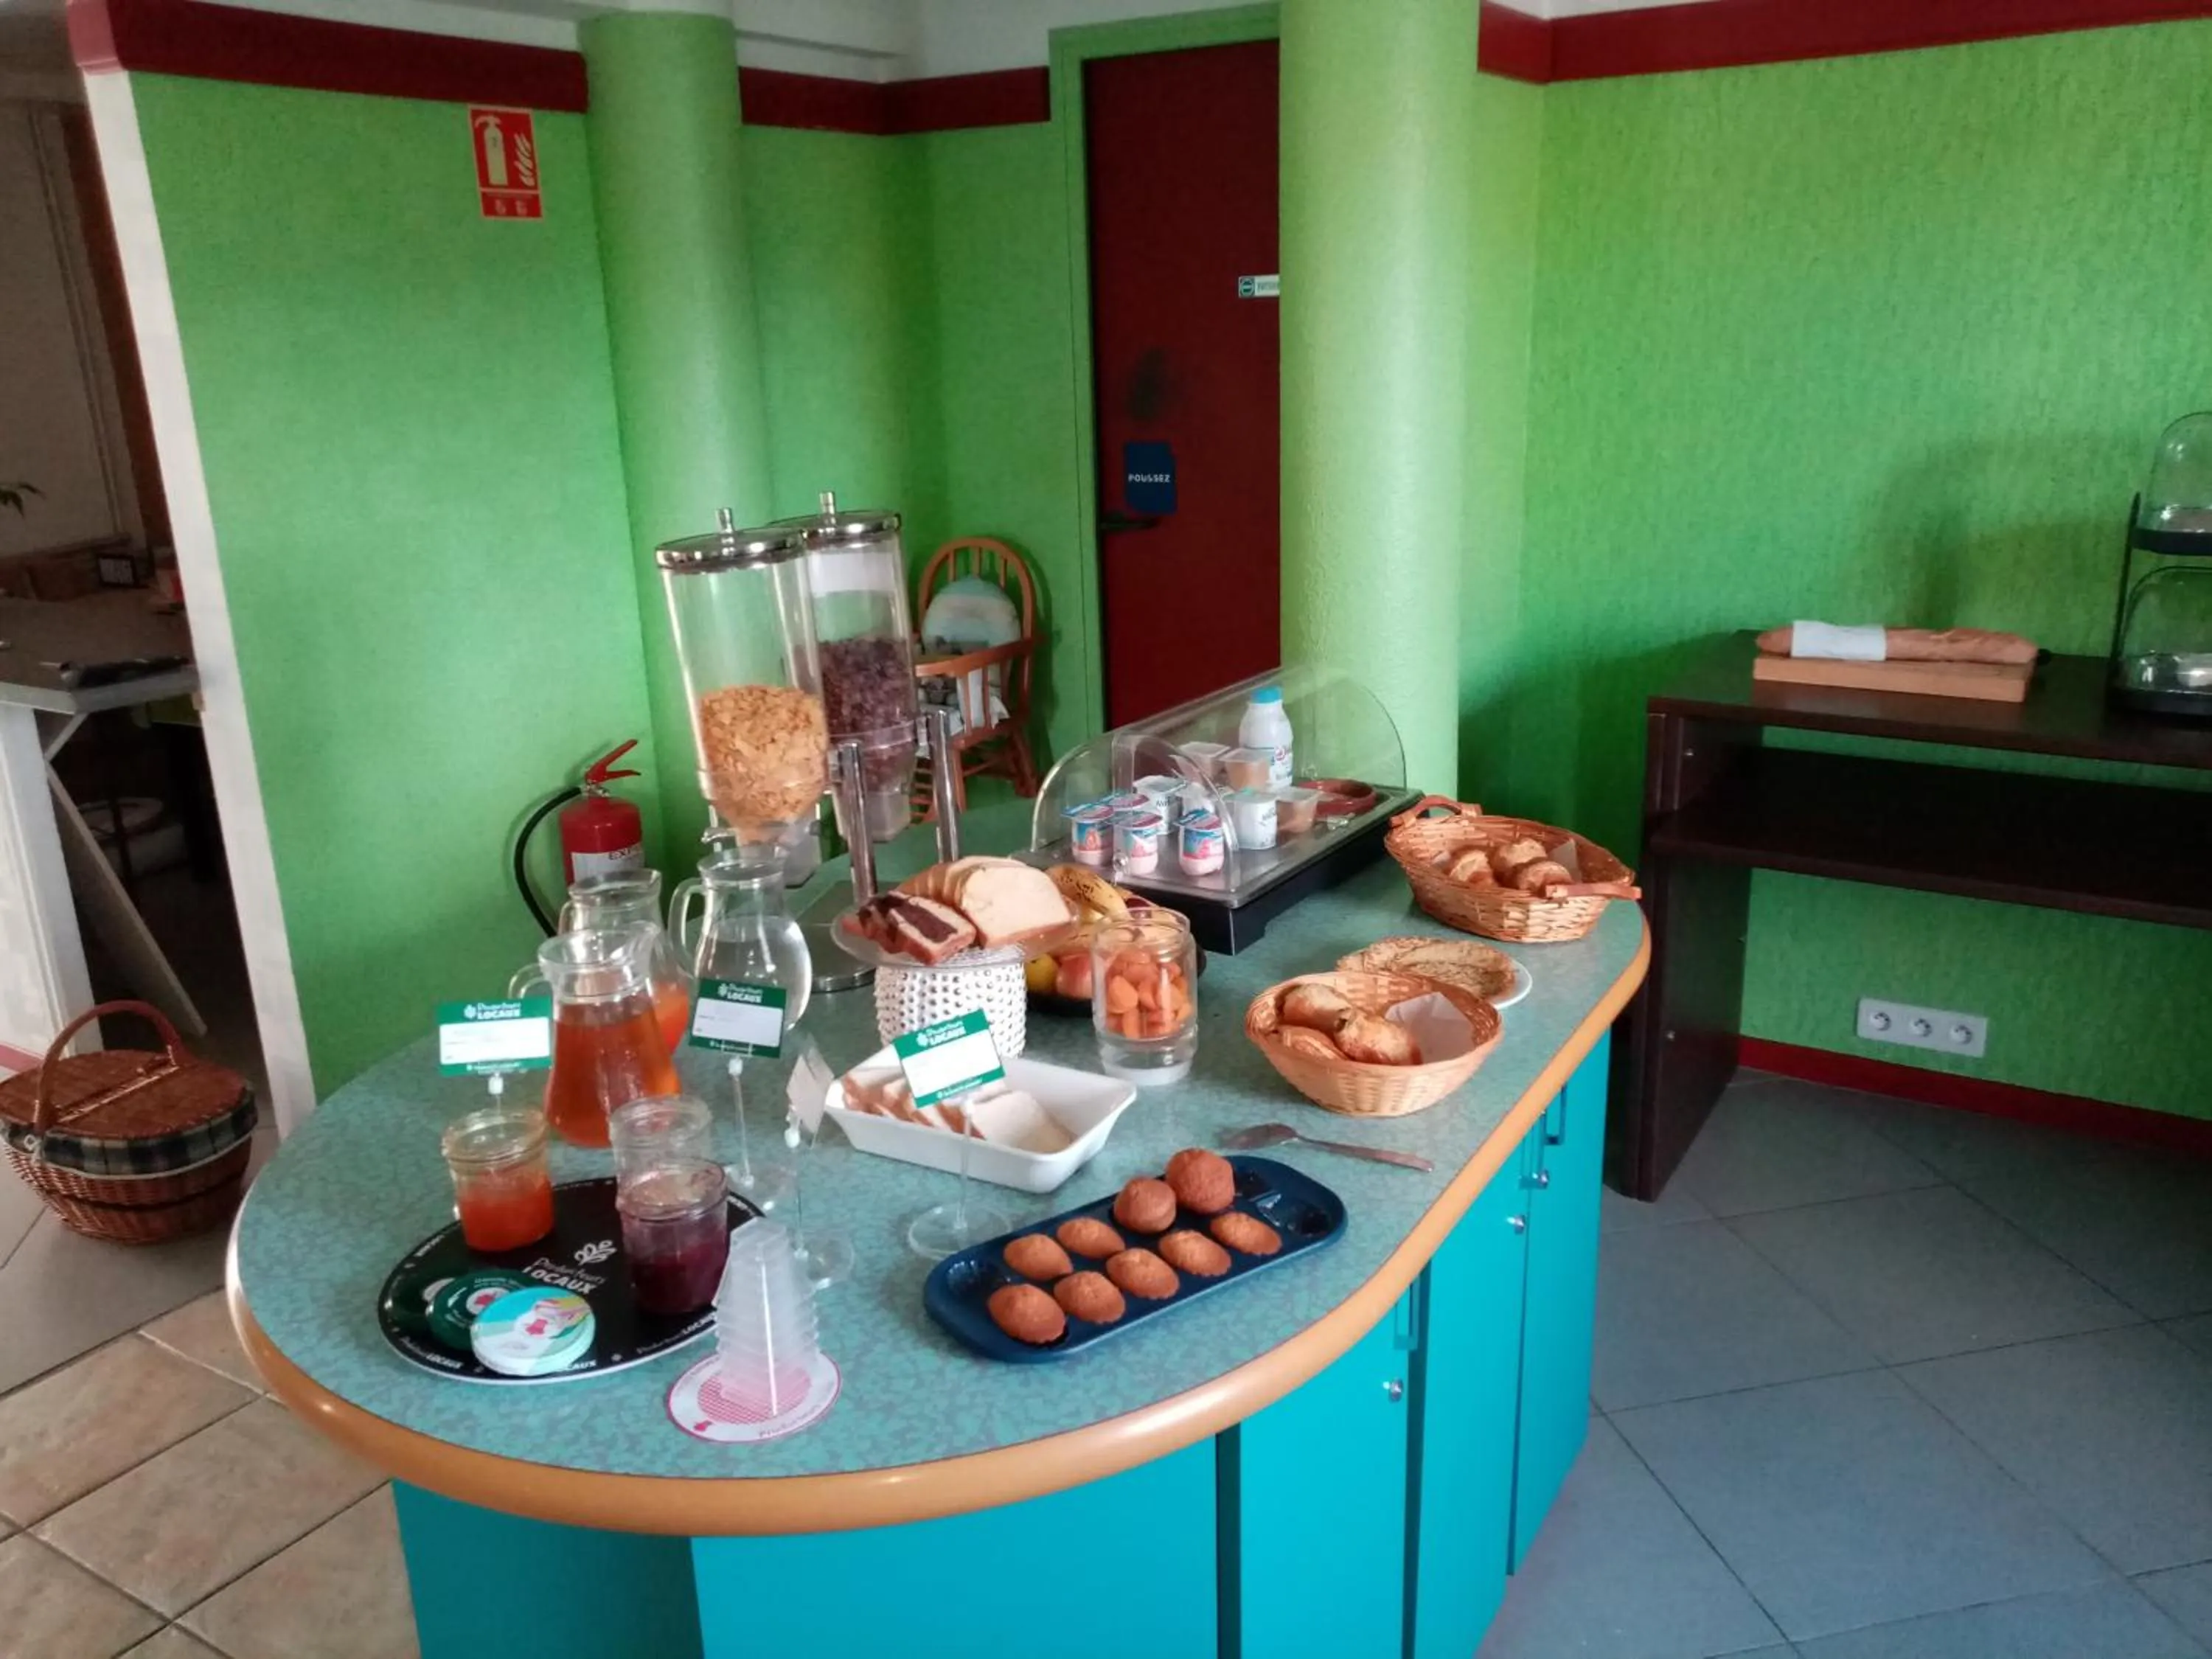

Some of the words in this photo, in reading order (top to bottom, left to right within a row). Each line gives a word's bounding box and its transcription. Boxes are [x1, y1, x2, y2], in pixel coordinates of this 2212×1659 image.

[1128, 473, 1170, 483] POUSSEZ
[727, 992, 762, 1004] LOCAUX
[477, 1008, 521, 1020] LOCAUX
[929, 1026, 967, 1046] LOCAUX
